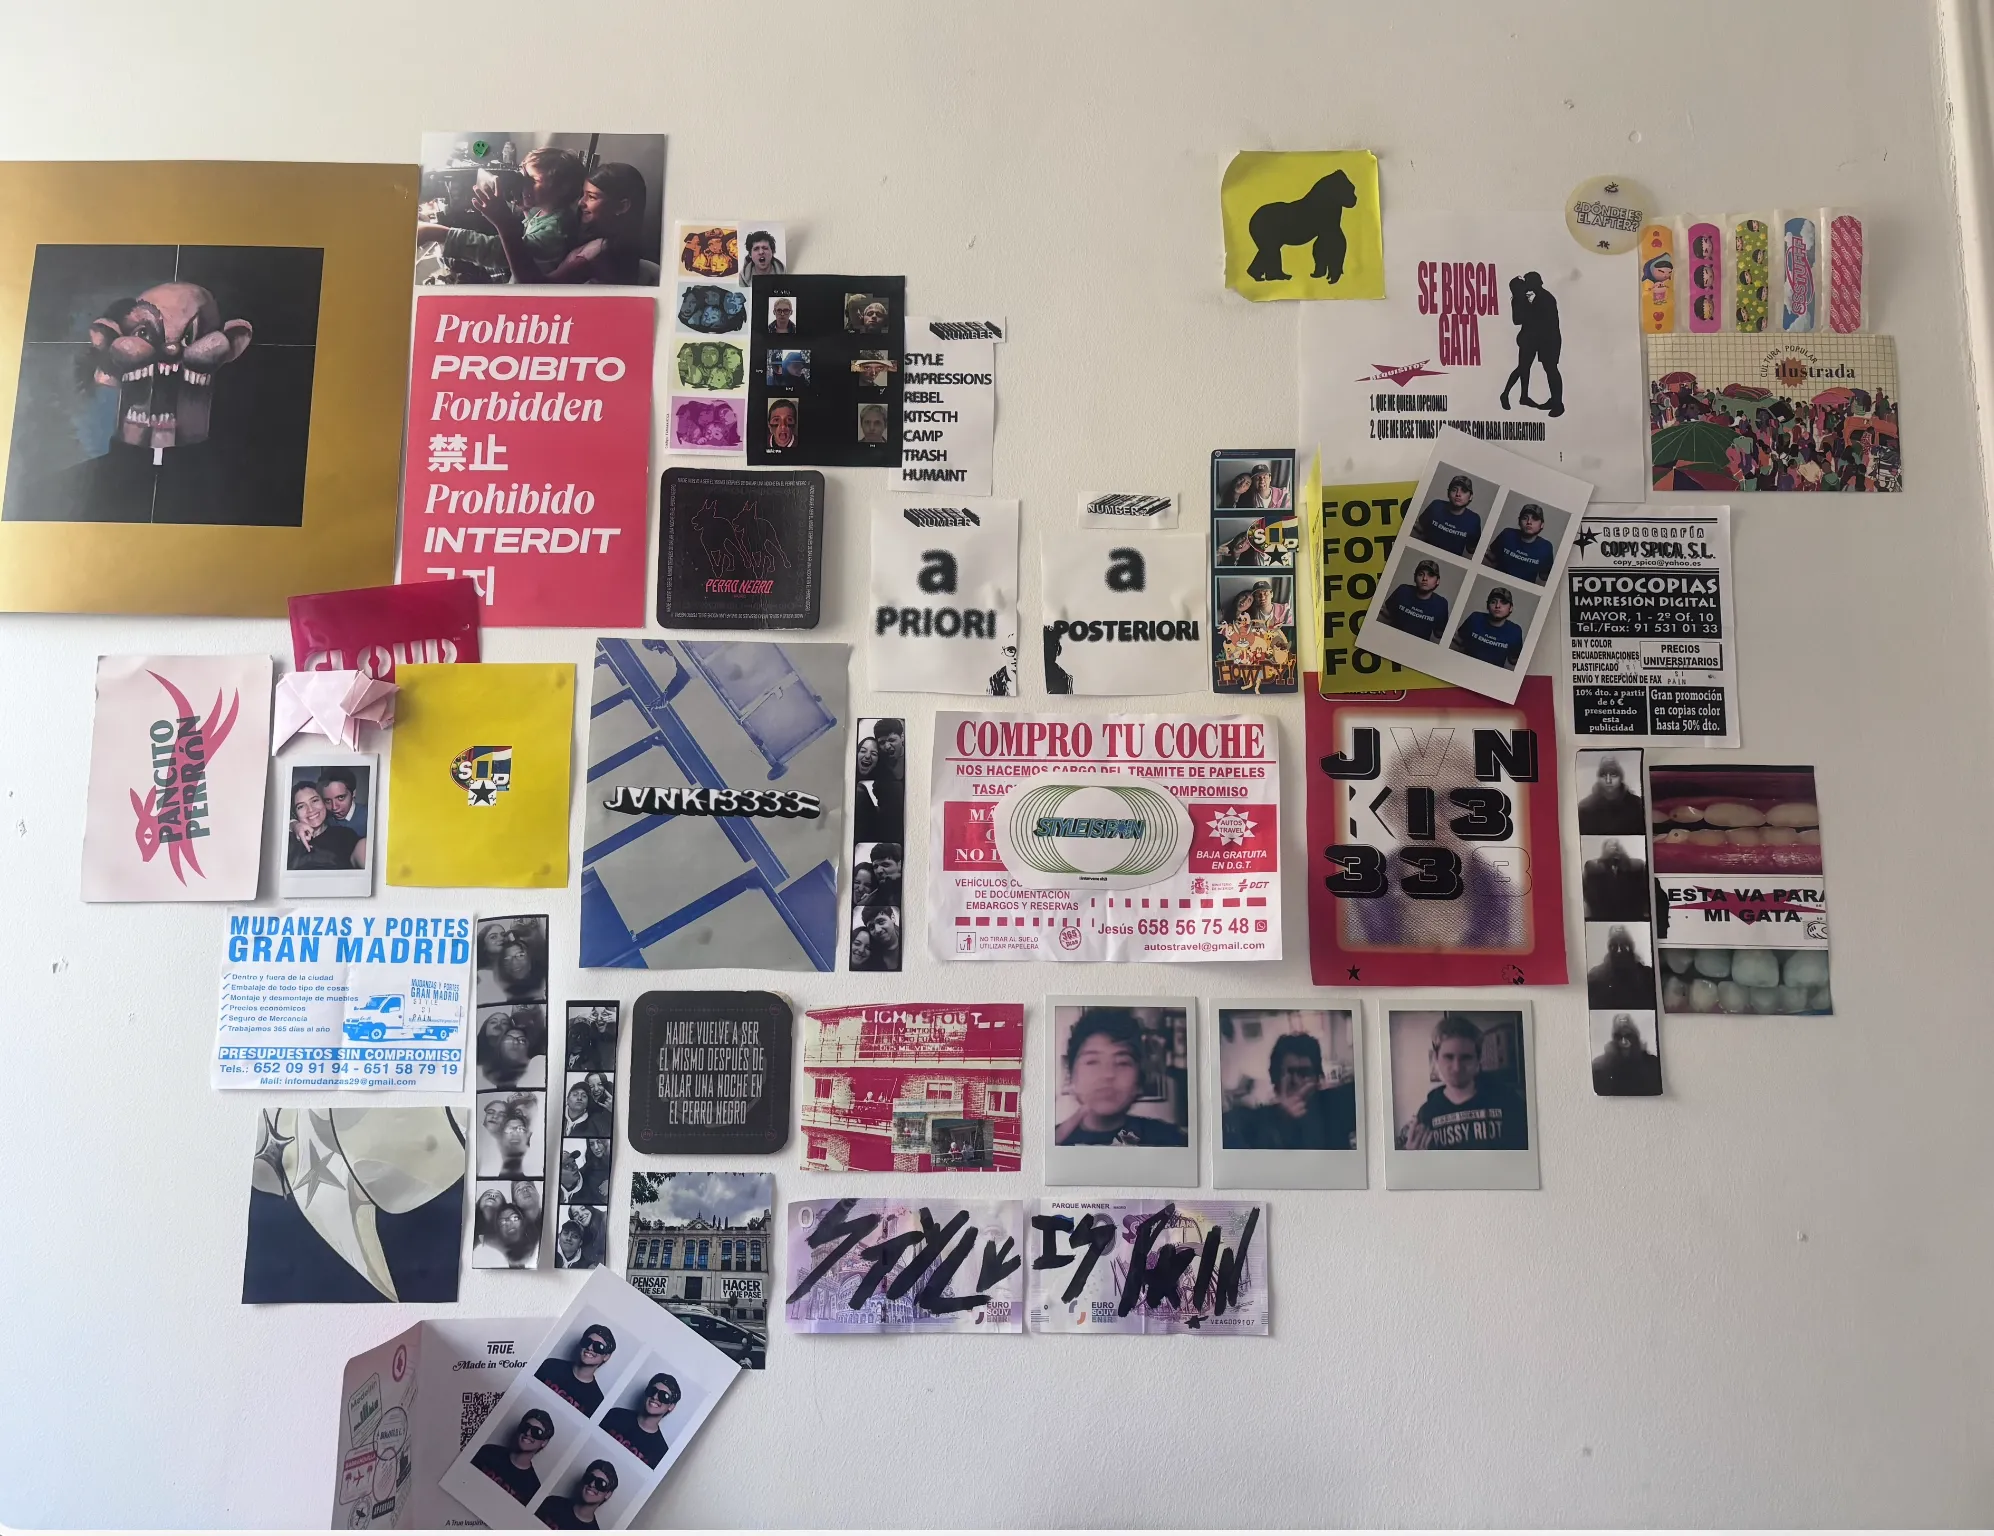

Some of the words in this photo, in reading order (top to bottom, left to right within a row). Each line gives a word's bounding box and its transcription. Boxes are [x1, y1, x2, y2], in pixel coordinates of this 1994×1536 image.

[1577, 212, 1591, 225] EL
[1590, 215, 1640, 232] AFTER?
[1626, 209, 1643, 223] ES
[1417, 261, 1438, 315] SE
[1441, 262, 1499, 316] BUSCA
[434, 314, 574, 344] Prohibit
[1438, 313, 1481, 366] GATA
[905, 353, 944, 366] STYLE
[1760, 348, 1781, 378] CULTURA
[1785, 345, 1818, 364] POPULAR
[430, 355, 626, 381] PROIBITO
[1775, 363, 1855, 379] ilustrada
[905, 373, 992, 385] IMPRESSIONS
[904, 391, 944, 403] REBEL
[1396, 394, 1416, 413] QUIERA
[430, 391, 604, 421] Forbidden
[904, 410, 958, 423] KITSCTH
[903, 430, 943, 442] CAMP
[1415, 420, 1435, 440] TODAS
[1486, 421, 1502, 441] BABA
[427, 433, 508, 473] 禁止
[903, 449, 947, 461] TRASH
[903, 469, 967, 482] HUMAINT
[424, 483, 595, 514] Prohibido
[1604, 525, 1705, 539] REPROGRAFÍA
[424, 527, 621, 553] INTERDIT
[1600, 541, 1639, 558] COPY
[917, 549, 958, 594] a
[1105, 547, 1145, 592] a
[705, 579, 739, 592] PERRO
[738, 580, 773, 594] NEGRO
[1572, 577, 1718, 595] FOTOCOPIAS
[1574, 595, 1655, 607] IMPRESIÓN
[1659, 597, 1717, 608] DIGITAL
[875, 606, 997, 639] PRIORI
[1580, 612, 1632, 623] MAYOR,
[1699, 613, 1714, 622] 10
[1054, 620, 1199, 642] POSTERIORI
[1577, 623, 1630, 633] Tel./Fax:
[1634, 623, 1649, 633] 91
[1654, 623, 1677, 633] 531
[1683, 624, 1697, 633] 01
[1702, 624, 1718, 634] 33
[1590, 640, 1613, 648] COLOR
[1661, 645, 1701, 654] PRECIOS
[1572, 651, 1640, 660] ENCUADERNACIONES
[1643, 657, 1719, 667] UNIVERSITARIOS
[1572, 663, 1619, 672] PLASTIFICADO
[1573, 673, 1594, 684] ENVÍO
[1600, 673, 1637, 684] RECEPCIÓN
[1649, 675, 1662, 684] FAX
[1575, 689, 1593, 697] 10%
[1621, 689, 1645, 699] partir
[1650, 689, 1673, 700] Gran
[1675, 689, 1723, 704] promoción
[1584, 708, 1638, 717] presentando
[1668, 706, 1697, 719] copias
[1699, 704, 1721, 716] color
[1589, 724, 1634, 733] publicidad
[1656, 718, 1681, 731] hasta
[1682, 719, 1701, 732] 50%
[1702, 718, 1721, 731] dto.
[956, 720, 1093, 758] COMPRO
[1102, 723, 1146, 759] TU
[1154, 723, 1265, 759] COCHE
[176, 716, 210, 839] PERRÓN
[956, 764, 982, 776] NOS
[987, 765, 1048, 776] HACEMOS
[1128, 766, 1184, 777] TRAMITE
[1189, 766, 1205, 778] DE
[1209, 767, 1265, 778] PAPELES
[150, 720, 183, 843] PANCITO
[955, 849, 985, 862] NO
[1196, 851, 1220, 859] BAJA
[1223, 850, 1267, 859] GRATUITA
[1211, 861, 1225, 870] EN
[1227, 860, 1252, 870] D.G.T.
[955, 877, 1008, 888] VEHÍCULOS
[1249, 881, 1269, 889] DGT
[975, 890, 987, 899] DE
[990, 889, 1071, 899] DOCUMENTACIÓN
[1668, 888, 1728, 902] ESTA
[1733, 888, 1766, 902] VA
[966, 901, 1020, 910] EMBARGOS
[1030, 901, 1079, 911] RESERVAS
[1704, 908, 1731, 922] MI
[1738, 909, 1801, 923] GATA
[230, 916, 353, 936] MUDANZAS
[363, 917, 376, 936] Y
[385, 918, 469, 938] PORTES
[1098, 922, 1134, 935] Jesús
[1137, 918, 1169, 935] 658
[1175, 919, 1196, 936] 56
[1201, 918, 1223, 935] 75
[1228, 917, 1250, 934] 48
[228, 936, 320, 963] GRAN
[335, 938, 470, 964] MADRID
[1144, 942, 1265, 952] autostravel@gmail.com
[666, 1021, 694, 1045] NADIE
[697, 1021, 730, 1045] VUELVE
[741, 1021, 760, 1047] SER
[219, 1048, 332, 1060] PRESUPUESTOS
[337, 1049, 360, 1060] SIN
[365, 1049, 460, 1061] COMPROMISO
[659, 1048, 668, 1071] EL
[672, 1048, 704, 1071] MISMO
[707, 1044, 749, 1071] DESPUÉS
[752, 1047, 764, 1071] DE
[253, 1062, 281, 1074] 652
[286, 1062, 304, 1074] 09
[308, 1062, 325, 1074] 91
[331, 1062, 349, 1074] 94
[363, 1063, 389, 1074] 651
[395, 1063, 413, 1074] 58
[419, 1063, 436, 1075] 79
[442, 1064, 458, 1075] 19
[285, 1077, 416, 1086] infomudanzas29@gmail.com
[658, 1074, 692, 1098] BAILAR
[694, 1074, 714, 1098] UNA
[717, 1074, 748, 1098] NOCHE
[750, 1074, 763, 1098] EN
[669, 1101, 679, 1125] EL
[682, 1101, 713, 1125] PERRO
[715, 1101, 747, 1125] NEGRO
[632, 1276, 667, 1288] PENSAR
[722, 1279, 761, 1292] HACER
[652, 1287, 666, 1295] SEA
[744, 1291, 762, 1299] PASE
[986, 1301, 1010, 1309] EURO
[1091, 1301, 1115, 1309] EURO
[453, 1360, 486, 1371] Made
[487, 1360, 497, 1369] in
[498, 1359, 527, 1370] Color
